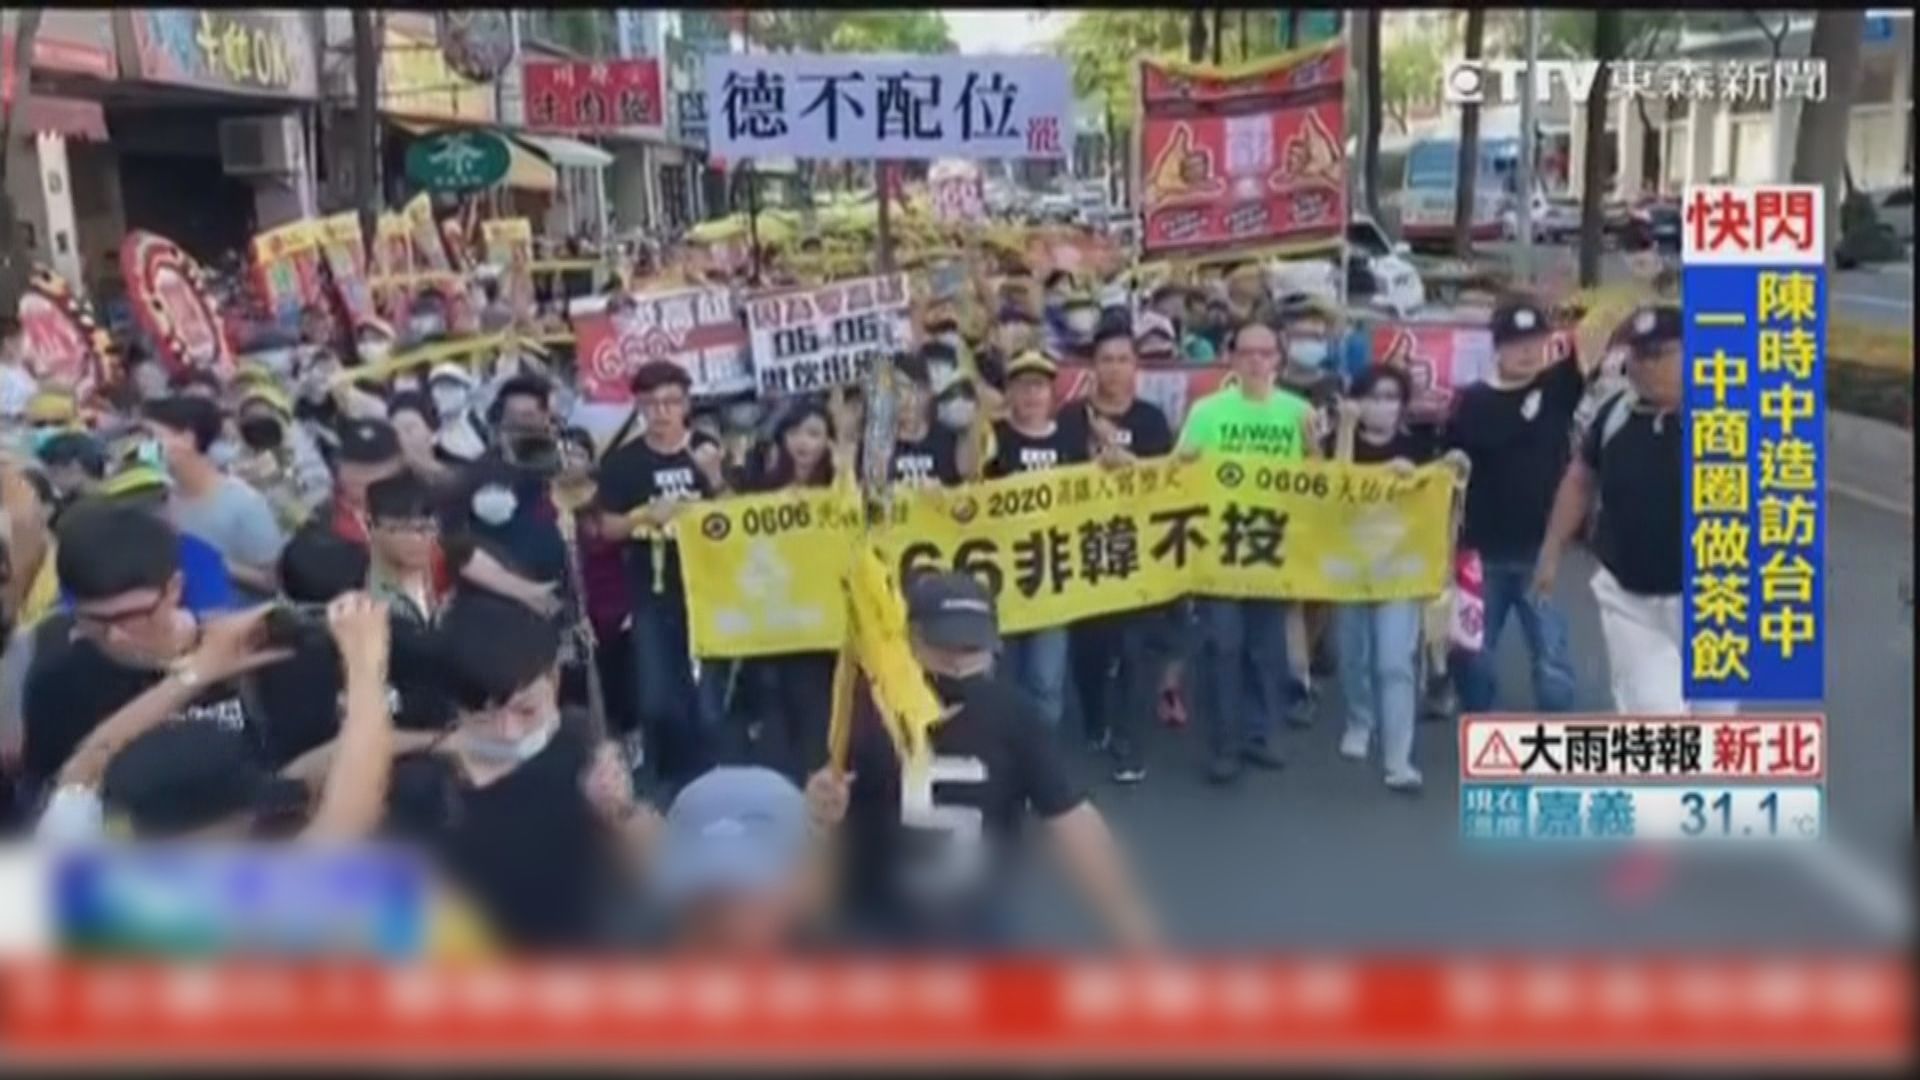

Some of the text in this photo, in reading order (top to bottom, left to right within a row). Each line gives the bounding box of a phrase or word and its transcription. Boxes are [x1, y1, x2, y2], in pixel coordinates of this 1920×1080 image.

[722, 70, 1021, 142] 德不配位
[1219, 422, 1294, 444] TAIWAN
[988, 483, 1052, 518] 2020
[1255, 468, 1329, 499] 0606
[743, 501, 811, 536] 0606
